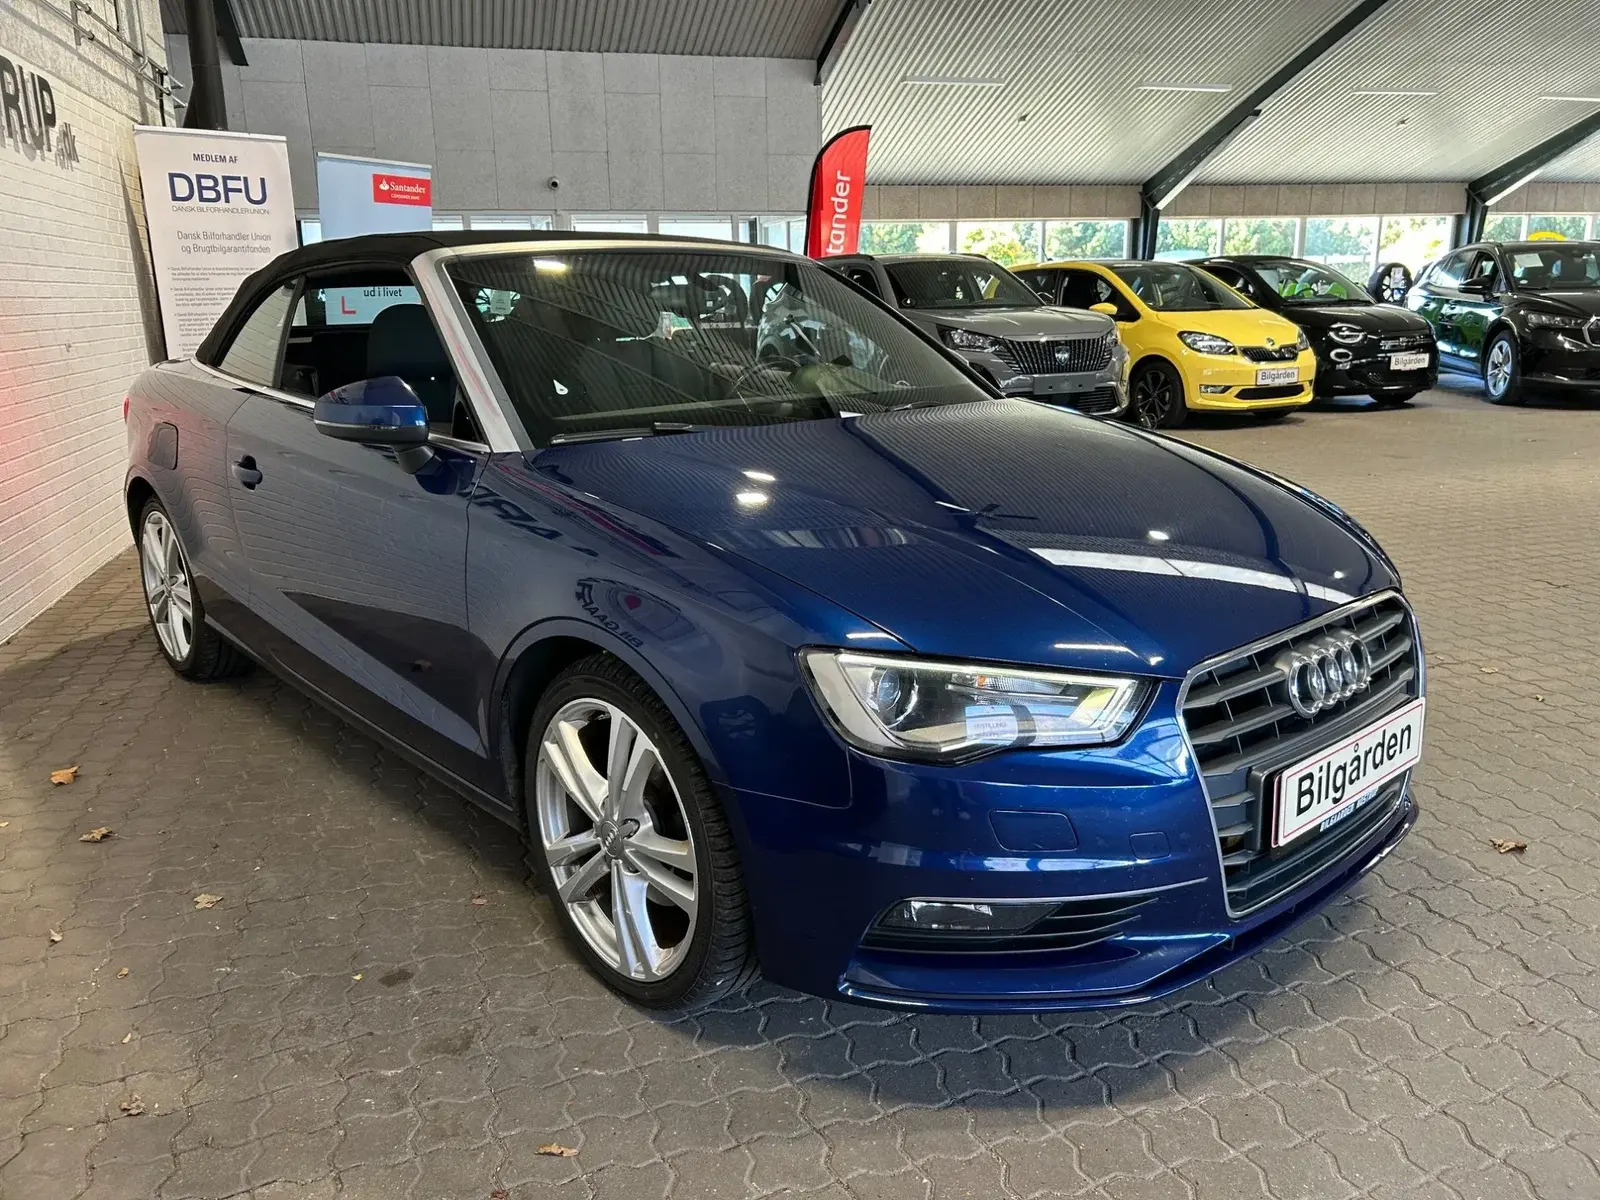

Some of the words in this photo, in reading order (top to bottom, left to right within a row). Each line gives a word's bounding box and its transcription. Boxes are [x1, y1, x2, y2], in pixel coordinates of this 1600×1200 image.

[193, 153, 227, 163] MEDLEM
[228, 155, 238, 164] AF
[168, 172, 267, 205] DBFU
[390, 181, 426, 194] Santander
[172, 205, 196, 213] DANSK
[197, 206, 249, 215] BILFORHANDLER
[249, 208, 270, 216] UNION
[826, 170, 851, 254] tander
[177, 231, 201, 240] Dansk
[203, 231, 249, 241] Bilforhandler
[251, 233, 271, 242] Union
[181, 245, 191, 254] og
[193, 243, 271, 254] Brugtbilgarantifonden
[363, 287, 376, 297] ud
[383, 287, 402, 297] livet
[1261, 370, 1295, 382] Bilgården
[1296, 724, 1411, 817] Bilgården
